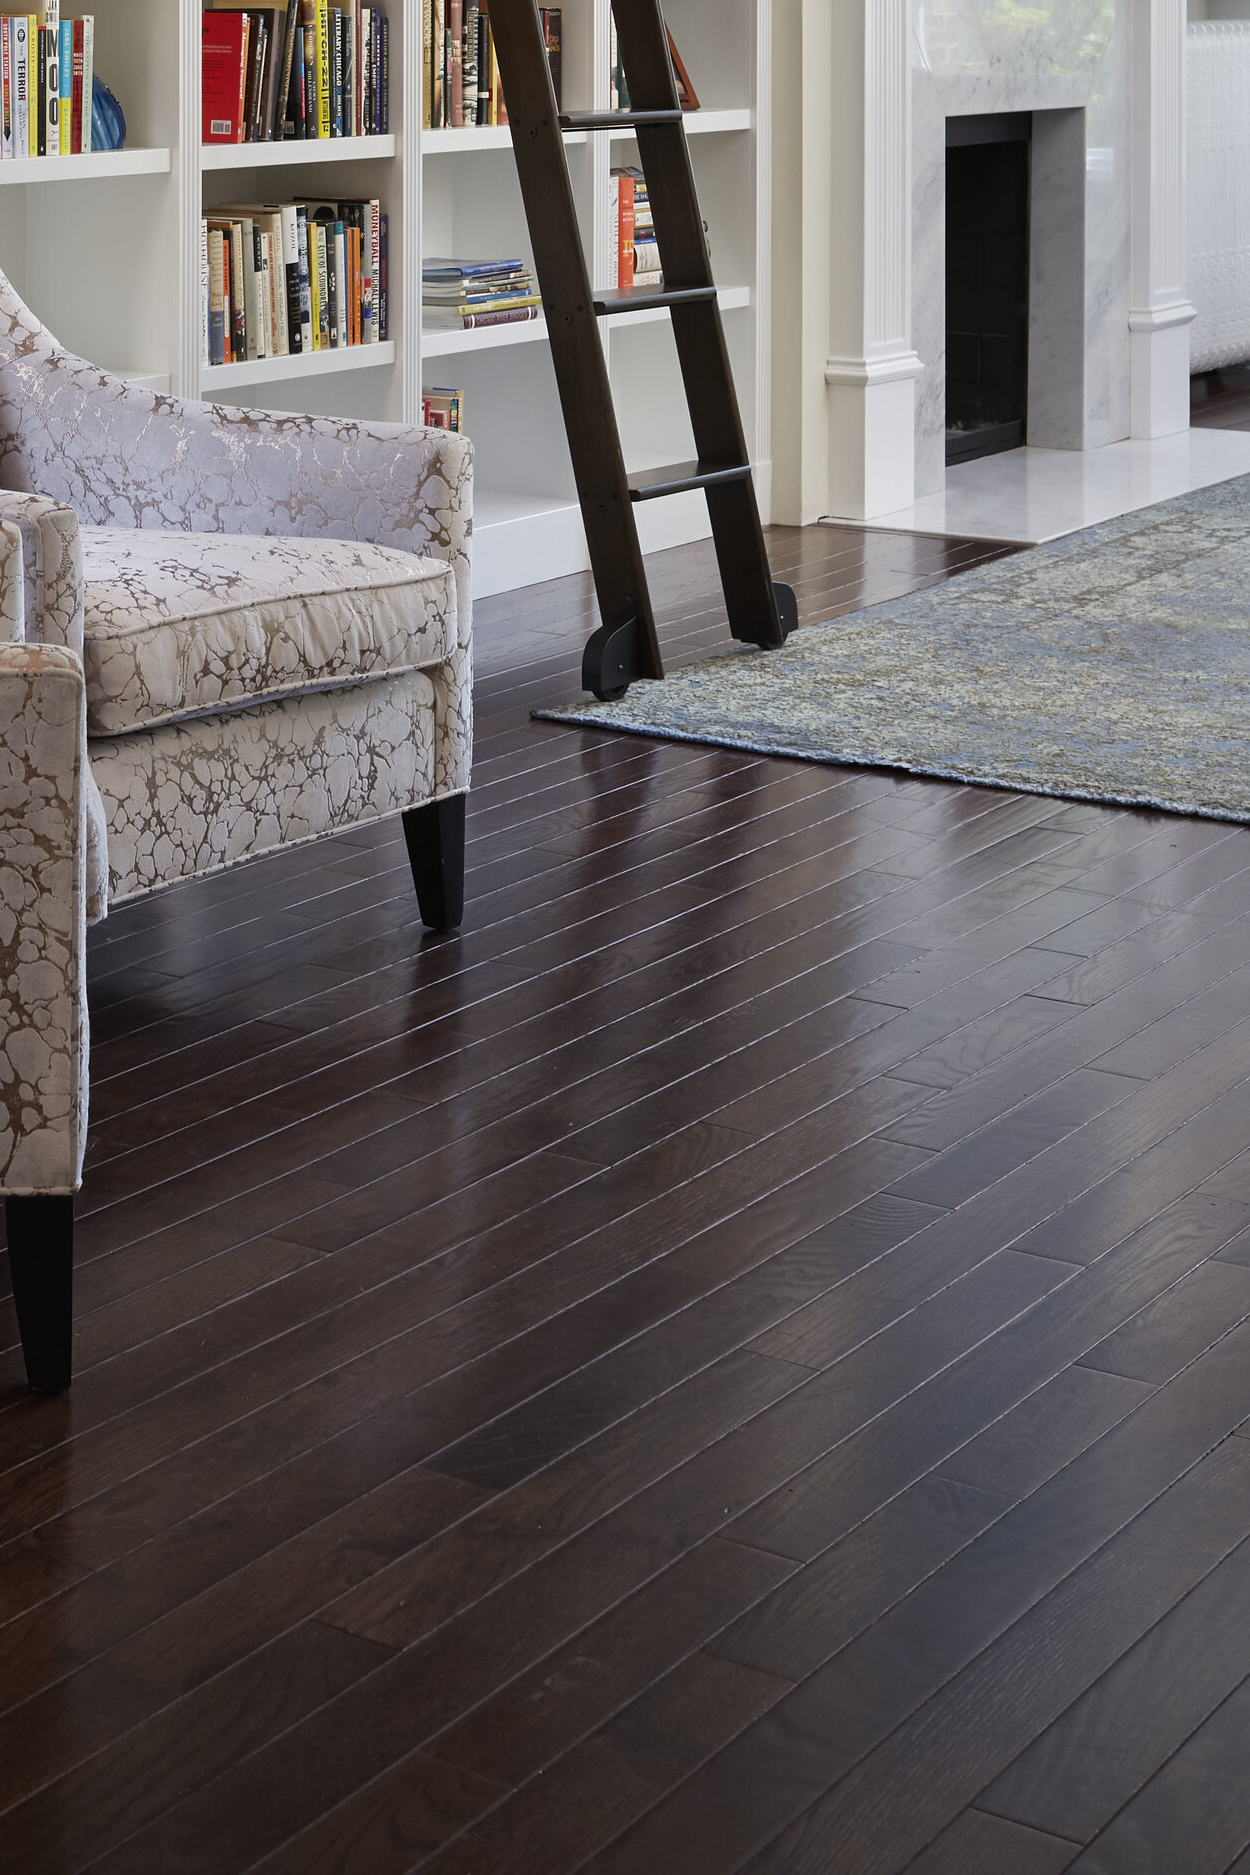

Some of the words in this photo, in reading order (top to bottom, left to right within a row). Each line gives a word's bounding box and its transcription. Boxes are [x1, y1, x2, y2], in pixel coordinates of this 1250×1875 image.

[320, 13, 328, 88] HITCH-22
[299, 219, 307, 228] Jon
[371, 205, 379, 266] MONEYBALL
[300, 232, 308, 274] Krakauer
[318, 245, 326, 260] CITY
[318, 261, 326, 269] OF
[319, 270, 327, 313] SCOUNDRELS
[371, 269, 379, 302] MICHAEL
[371, 304, 379, 325] LEWIS
